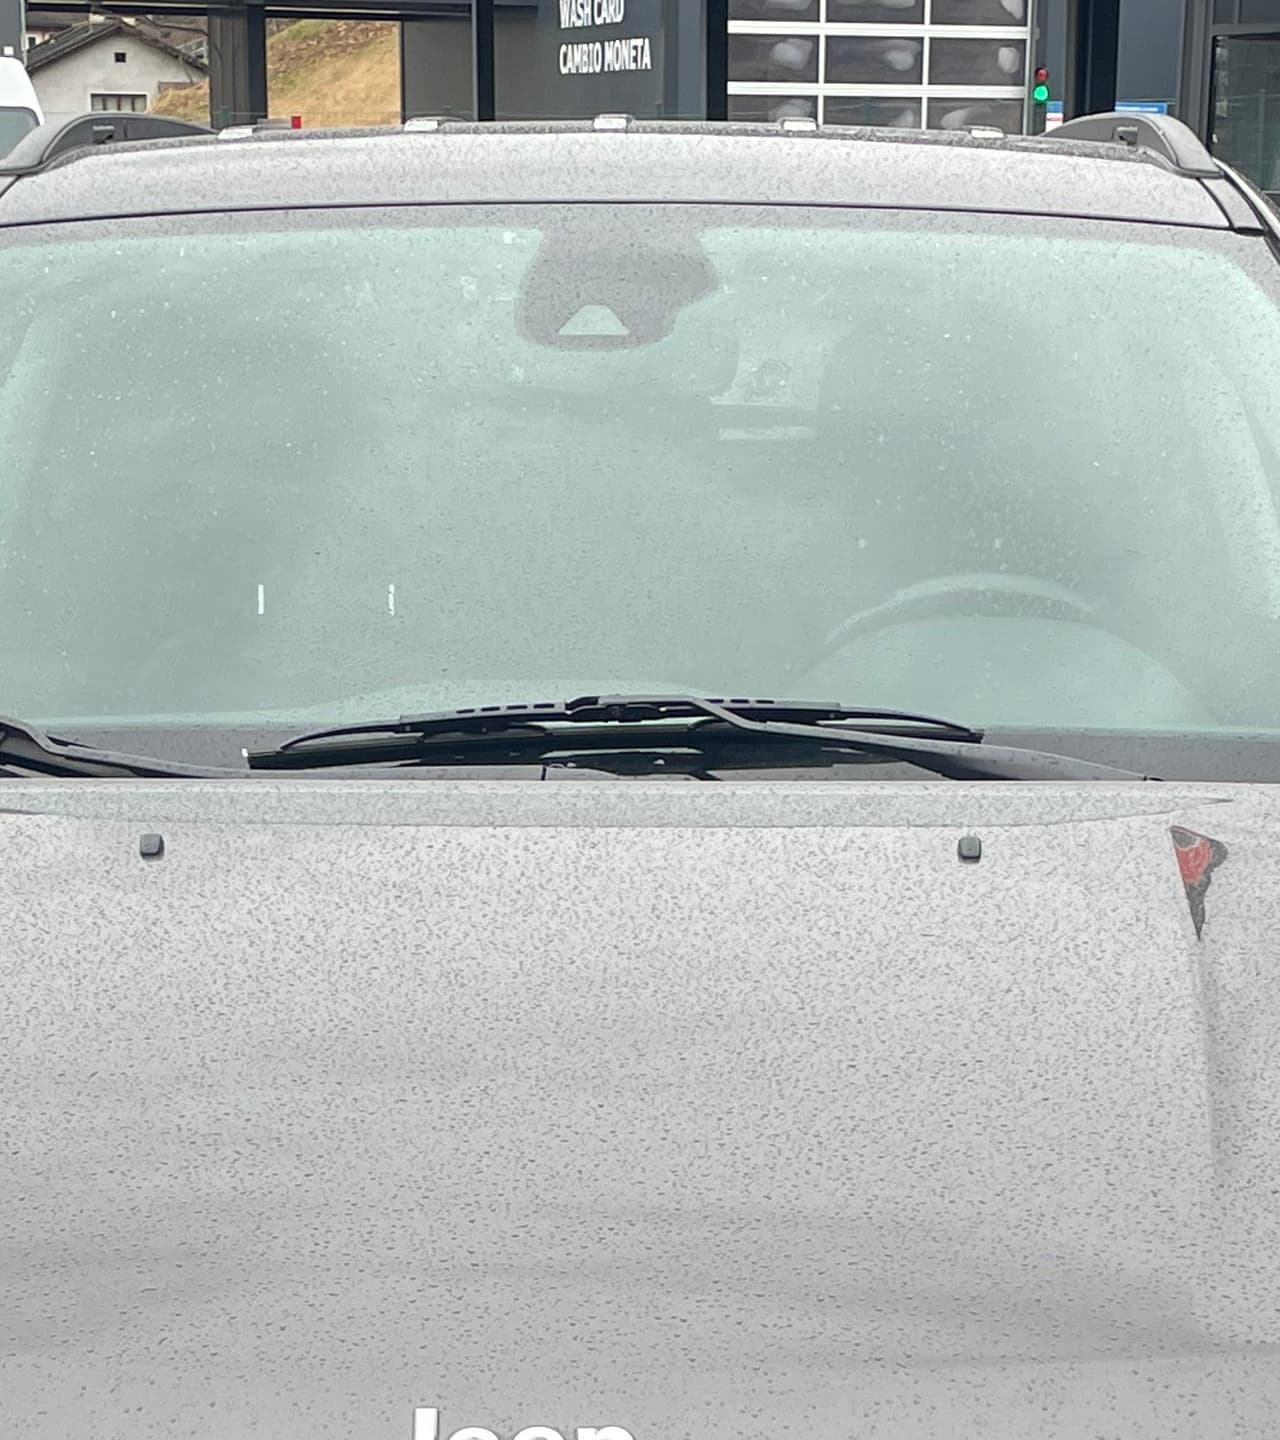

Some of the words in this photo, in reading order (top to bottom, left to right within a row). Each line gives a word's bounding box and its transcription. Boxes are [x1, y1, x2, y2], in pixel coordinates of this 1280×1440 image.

[559, 0, 592, 28] WASH
[593, 0, 625, 25] CARD
[559, 42, 602, 74] CAMBIO
[604, 37, 652, 72] MONETA
